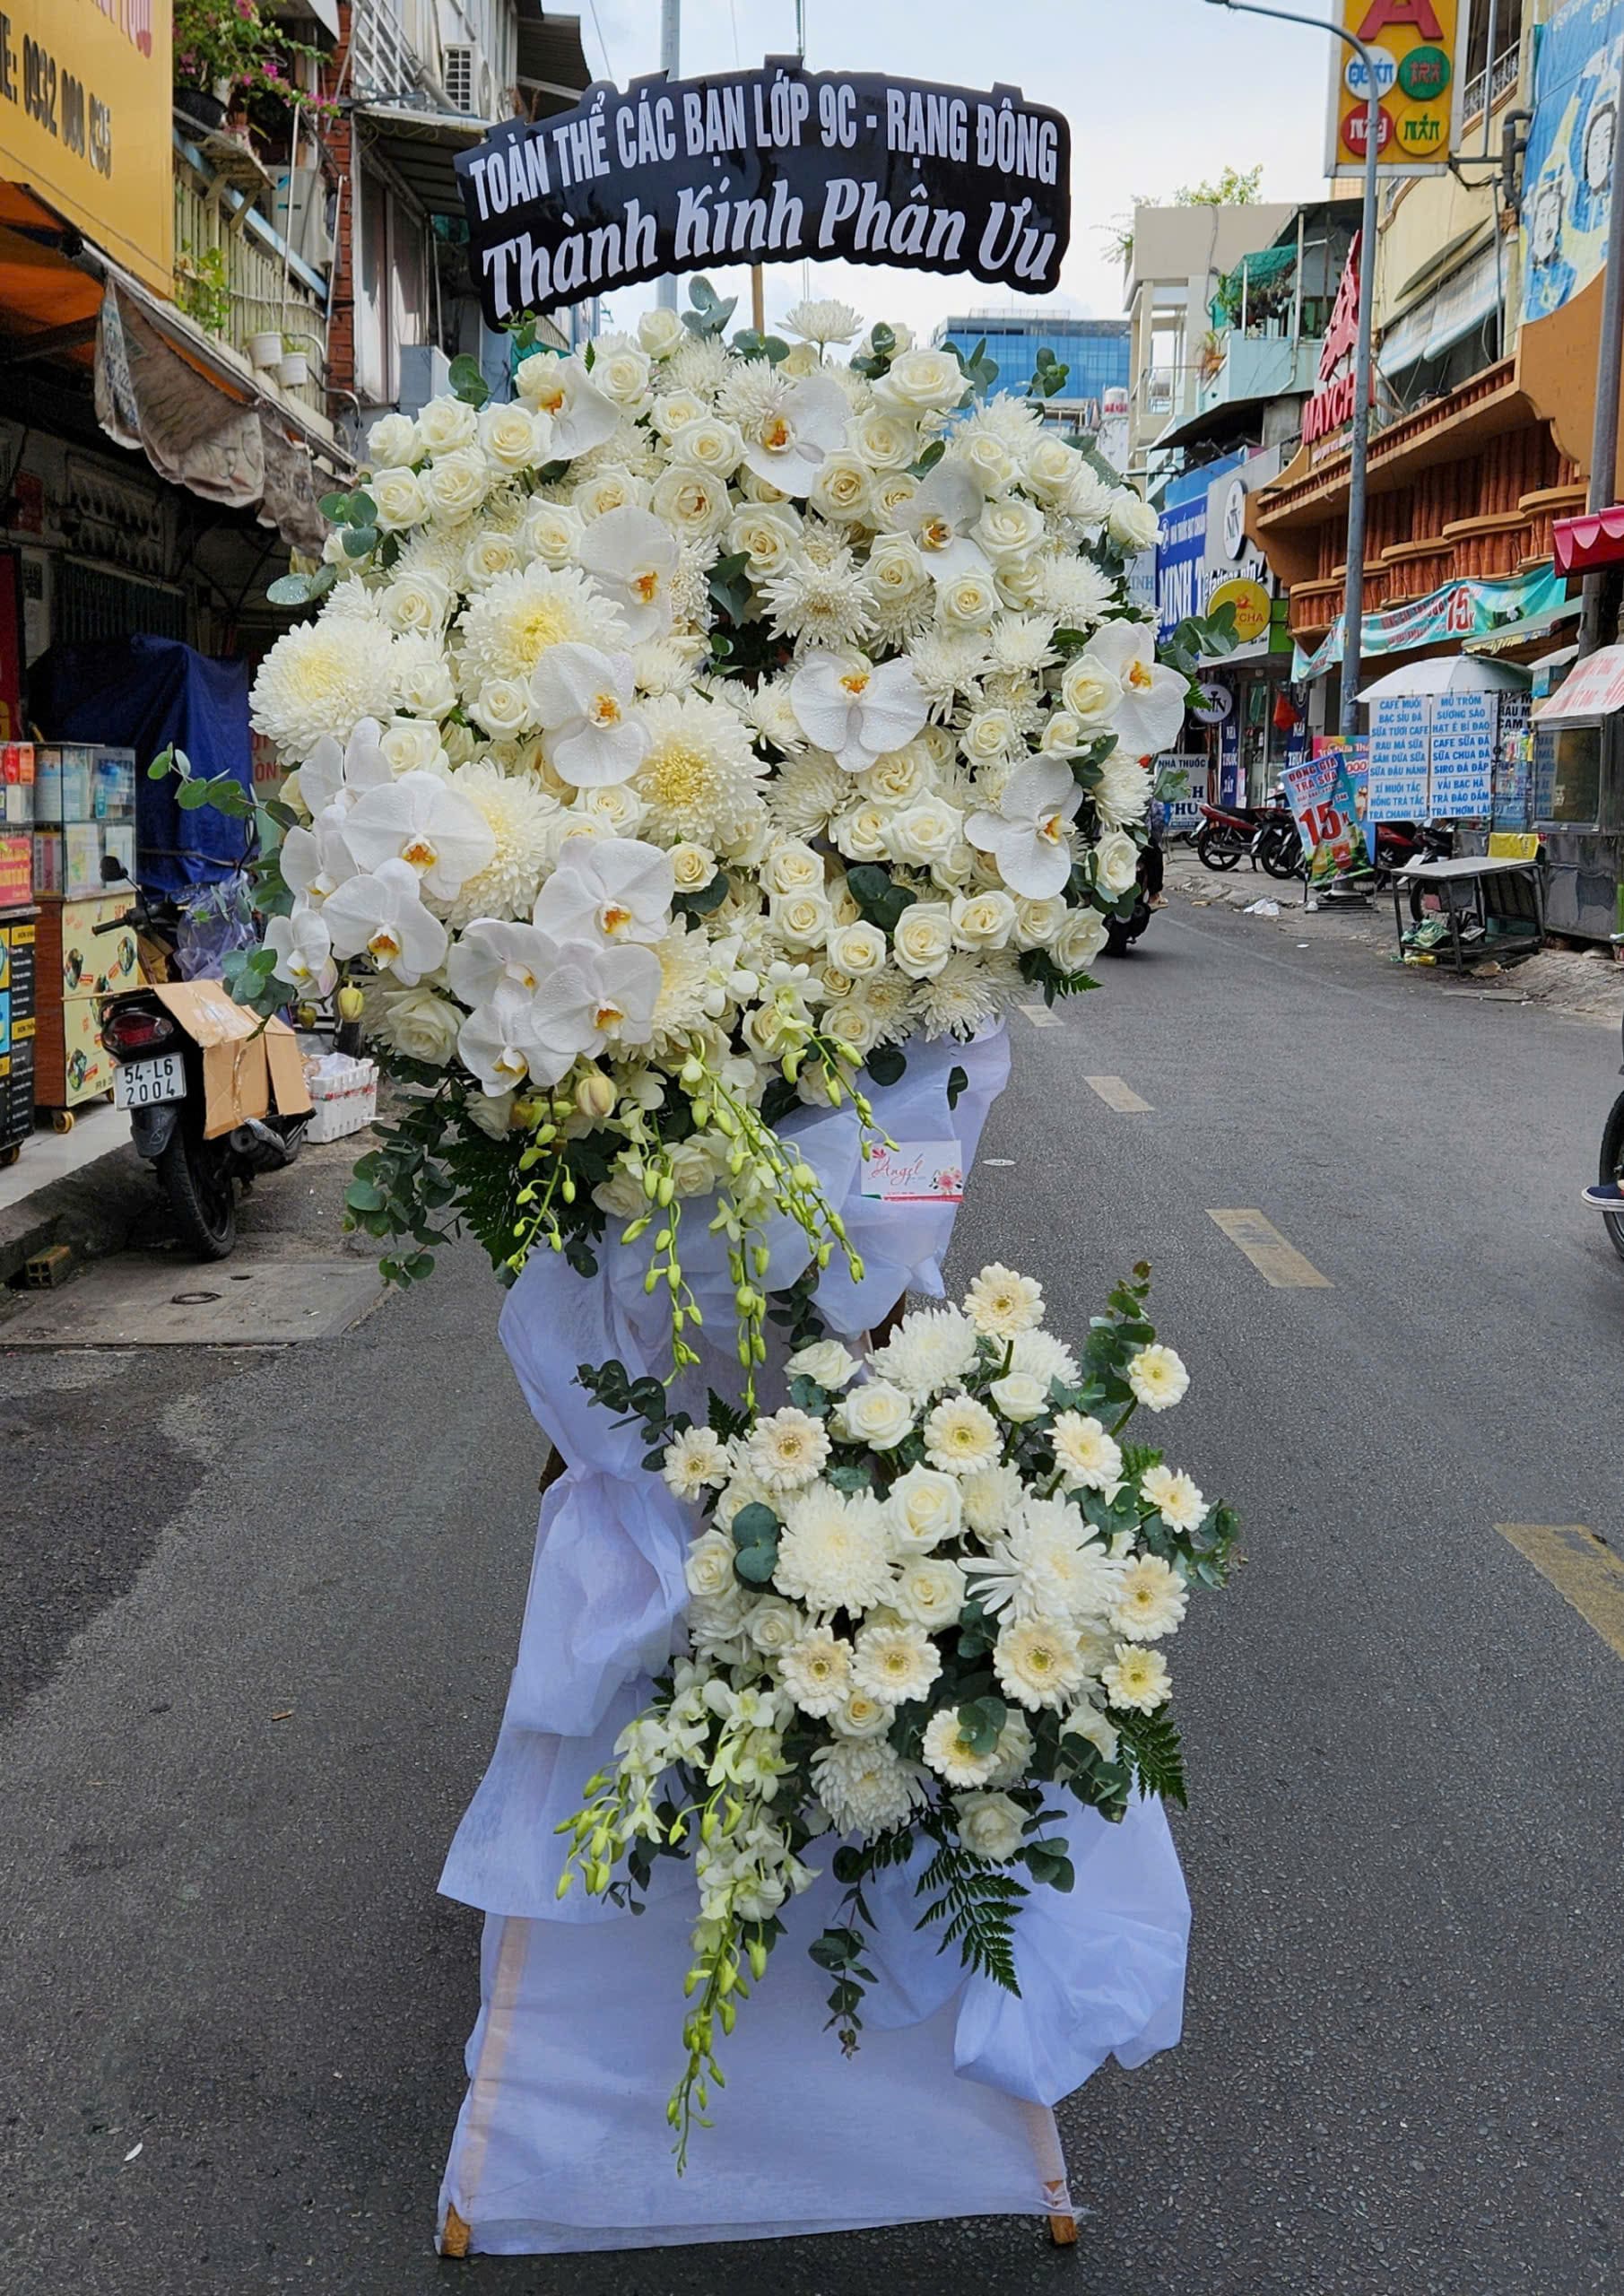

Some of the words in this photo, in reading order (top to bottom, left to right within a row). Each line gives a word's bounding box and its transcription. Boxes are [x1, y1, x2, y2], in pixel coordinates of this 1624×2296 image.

[469, 133, 549, 221] TOÀN
[553, 91, 611, 189] THỂ
[615, 83, 676, 169] CÁC
[683, 84, 747, 167] BẠN
[754, 69, 809, 149] LỚP
[819, 83, 857, 148] 9C
[887, 88, 968, 169] RẠNG
[977, 97, 1059, 187] ĐÔNG
[482, 197, 658, 320] Thành
[674, 177, 803, 257] Kính
[818, 178, 968, 259] Phân
[979, 196, 1056, 281] Ưu
[1131, 576, 1154, 589] INH
[1238, 613, 1264, 622] CHA
[1410, 726, 1429, 735] CAFE
[1376, 742, 1391, 750] RAU
[1434, 738, 1455, 747] CAFE
[1433, 750, 1450, 761] SỮA
[1453, 751, 1475, 760] CHUA
[1159, 758, 1176, 768] NHÀ
[1179, 757, 1206, 769] THUỐC
[1434, 764, 1454, 774] SIRO
[1432, 793, 1448, 804] TRÀ
[1431, 805, 1446, 816] TRÀ
[124, 1058, 173, 1084] 54-L6
[126, 1078, 176, 1105] 2004
